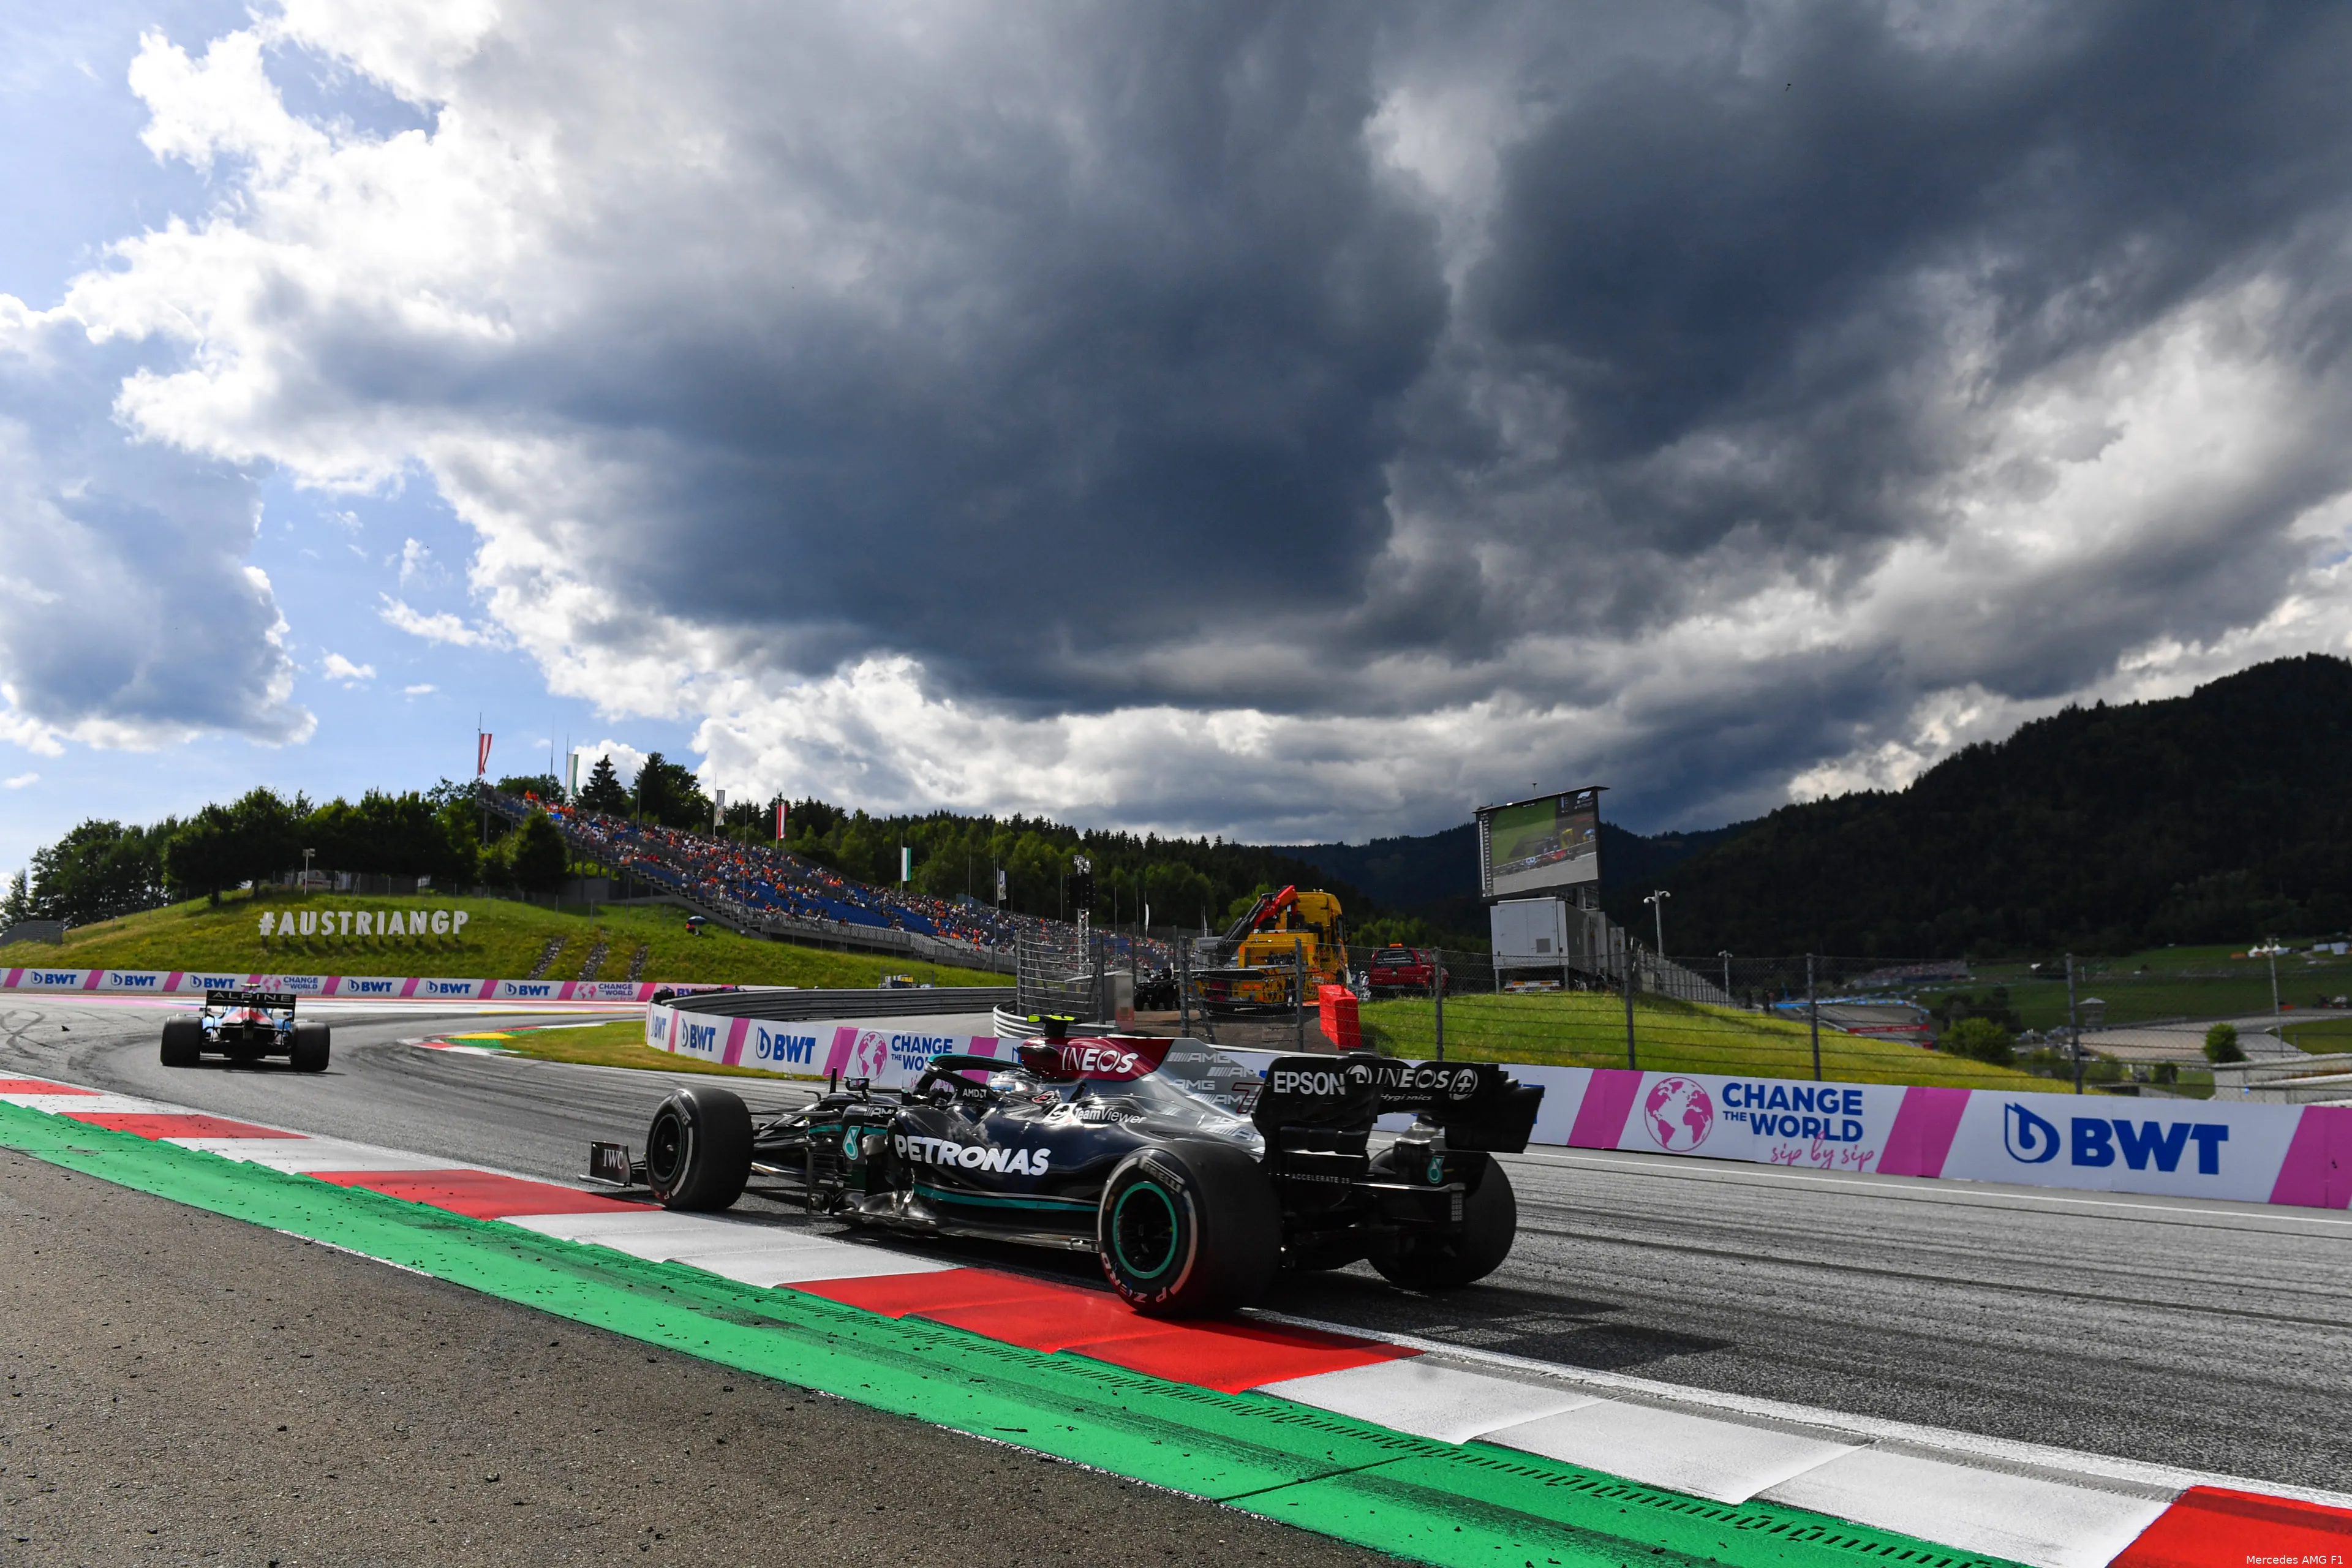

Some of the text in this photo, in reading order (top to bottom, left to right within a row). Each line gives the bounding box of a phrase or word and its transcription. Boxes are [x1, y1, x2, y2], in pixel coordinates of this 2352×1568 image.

[258, 910, 469, 936] #AUSTRIANGP
[45, 973, 77, 985] BWT
[124, 975, 156, 986] BWT
[204, 978, 236, 989] BWT
[361, 981, 393, 992] BWT
[440, 983, 471, 994] BWT
[212, 991, 292, 1002] ALPINE
[519, 985, 551, 997] BWT
[654, 1016, 667, 1041] BWT
[690, 1023, 716, 1052] BWT
[773, 1033, 816, 1065] BWT
[891, 1035, 953, 1055] CHANGE
[1061, 1047, 1139, 1074] INEOS
[1187, 1052, 1232, 1064] AMG
[1173, 1079, 1216, 1090] AMG
[1273, 1071, 1346, 1095] EPSON
[1376, 1068, 1450, 1088] INEOS
[962, 1088, 979, 1098] AMD
[1722, 1082, 1863, 1116] CHANGE
[1074, 1107, 1147, 1124] TeamViewer
[1723, 1110, 1864, 1142] THE WORLD
[894, 1134, 1052, 1176] PETRONAS
[1771, 1131, 1875, 1172] sip by sip
[2071, 1117, 2230, 1175] BWT
[603, 1148, 624, 1169] IWC
[1292, 1174, 1339, 1183] ACCELERATE
